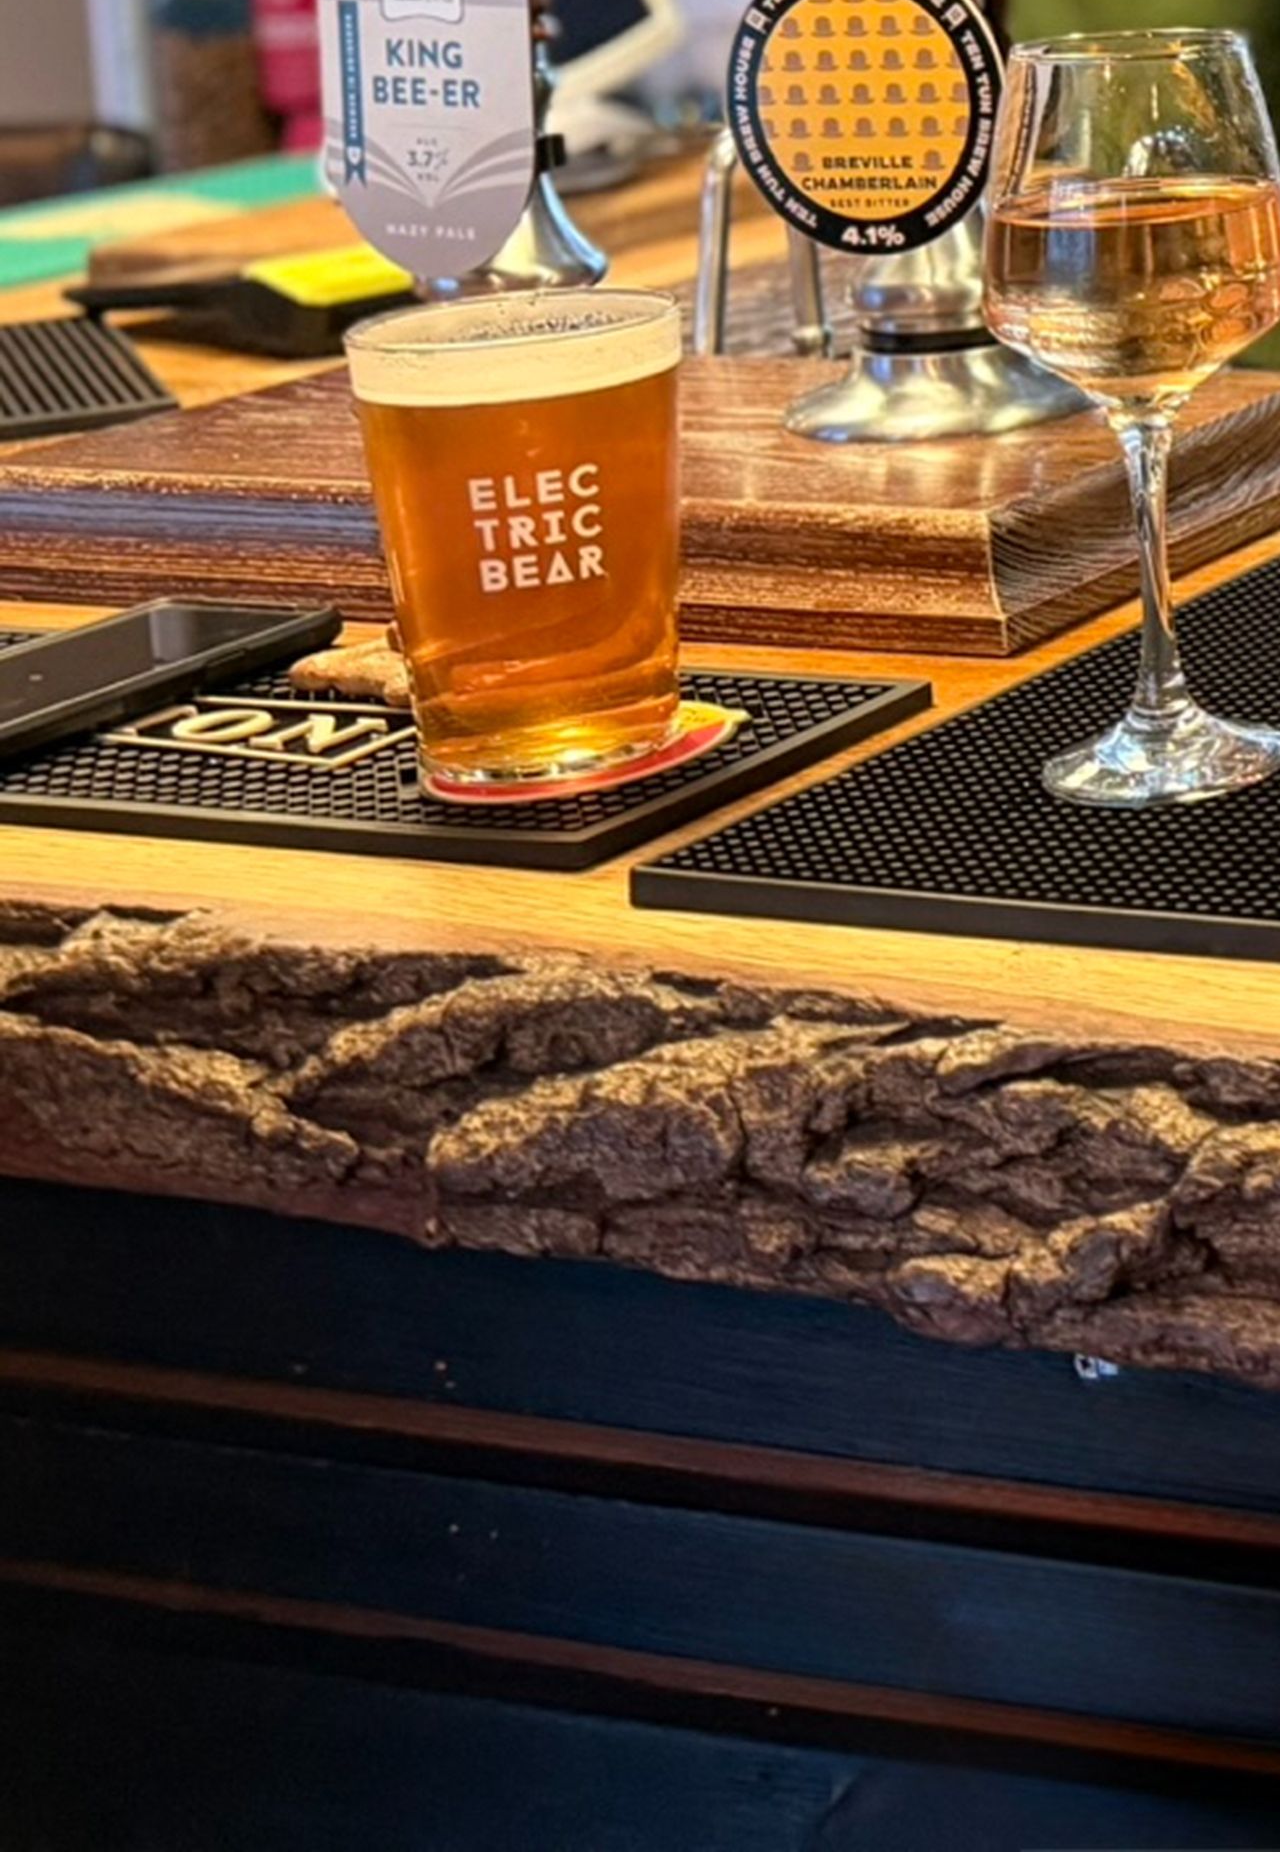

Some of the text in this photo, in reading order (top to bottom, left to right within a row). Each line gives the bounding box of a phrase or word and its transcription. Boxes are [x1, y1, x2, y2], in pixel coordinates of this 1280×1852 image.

[385, 38, 464, 70] KING
[372, 74, 481, 108] BEE-ER
[733, 35, 818, 229] TEN TUN BREW HOUSE
[923, 29, 993, 228] TEN TUN BREW HOUSE
[821, 156, 914, 170] BREVILLE
[801, 176, 938, 191] CHAMBERLAIN
[830, 198, 910, 209] BEST BITTER
[386, 223, 477, 240] HAZY PALE
[840, 224, 906, 247] 4.1%
[468, 463, 600, 512] ELEC
[474, 504, 603, 552] TRIC
[478, 545, 605, 593] BEAR
